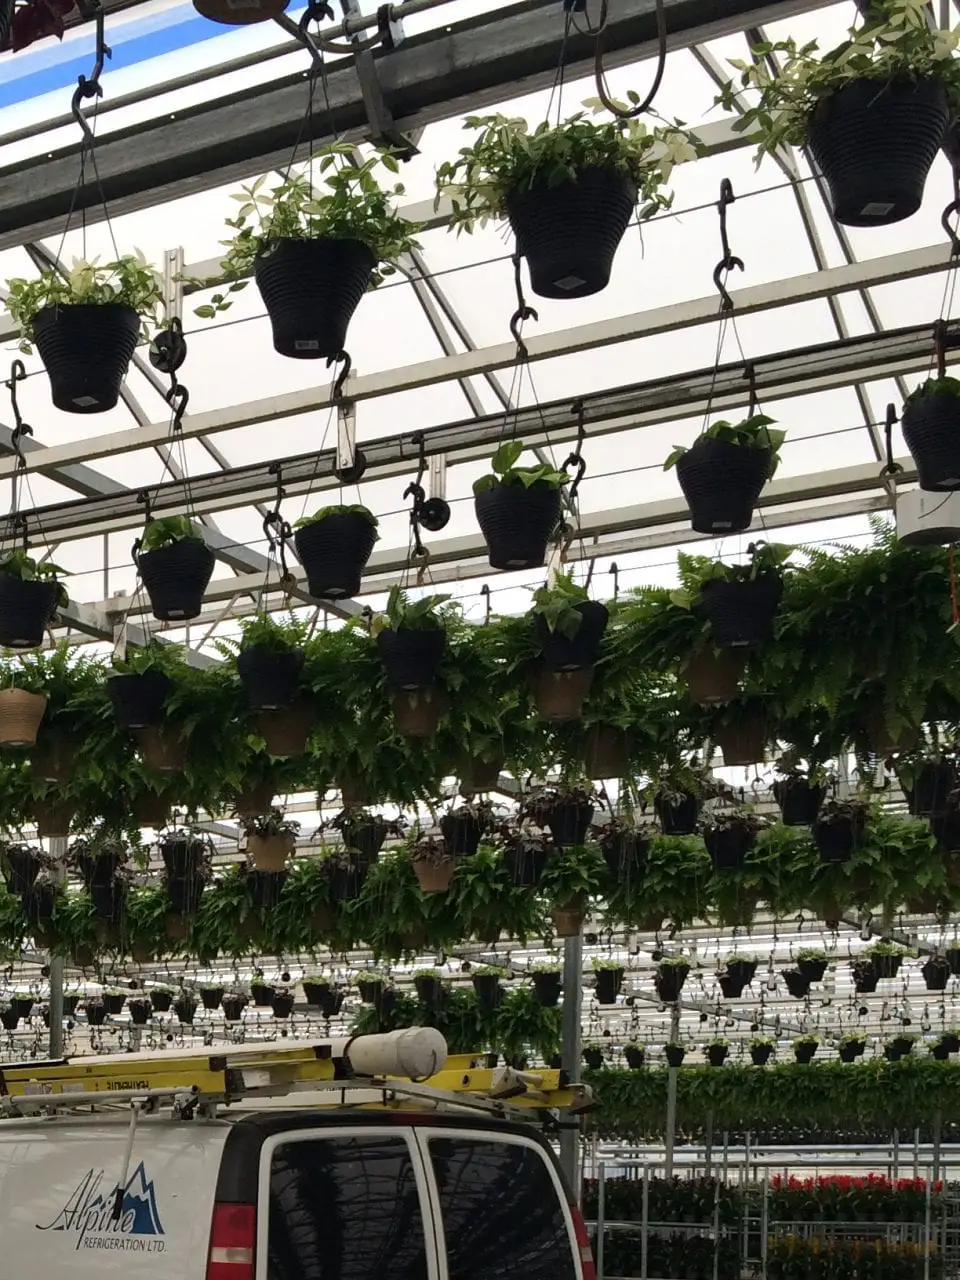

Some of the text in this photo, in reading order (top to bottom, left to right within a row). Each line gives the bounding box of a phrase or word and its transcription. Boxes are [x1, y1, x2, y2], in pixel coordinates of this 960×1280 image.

[35, 1167, 136, 1250] Alpine
[84, 1237, 167, 1252] REFRIGERATION LTD.
